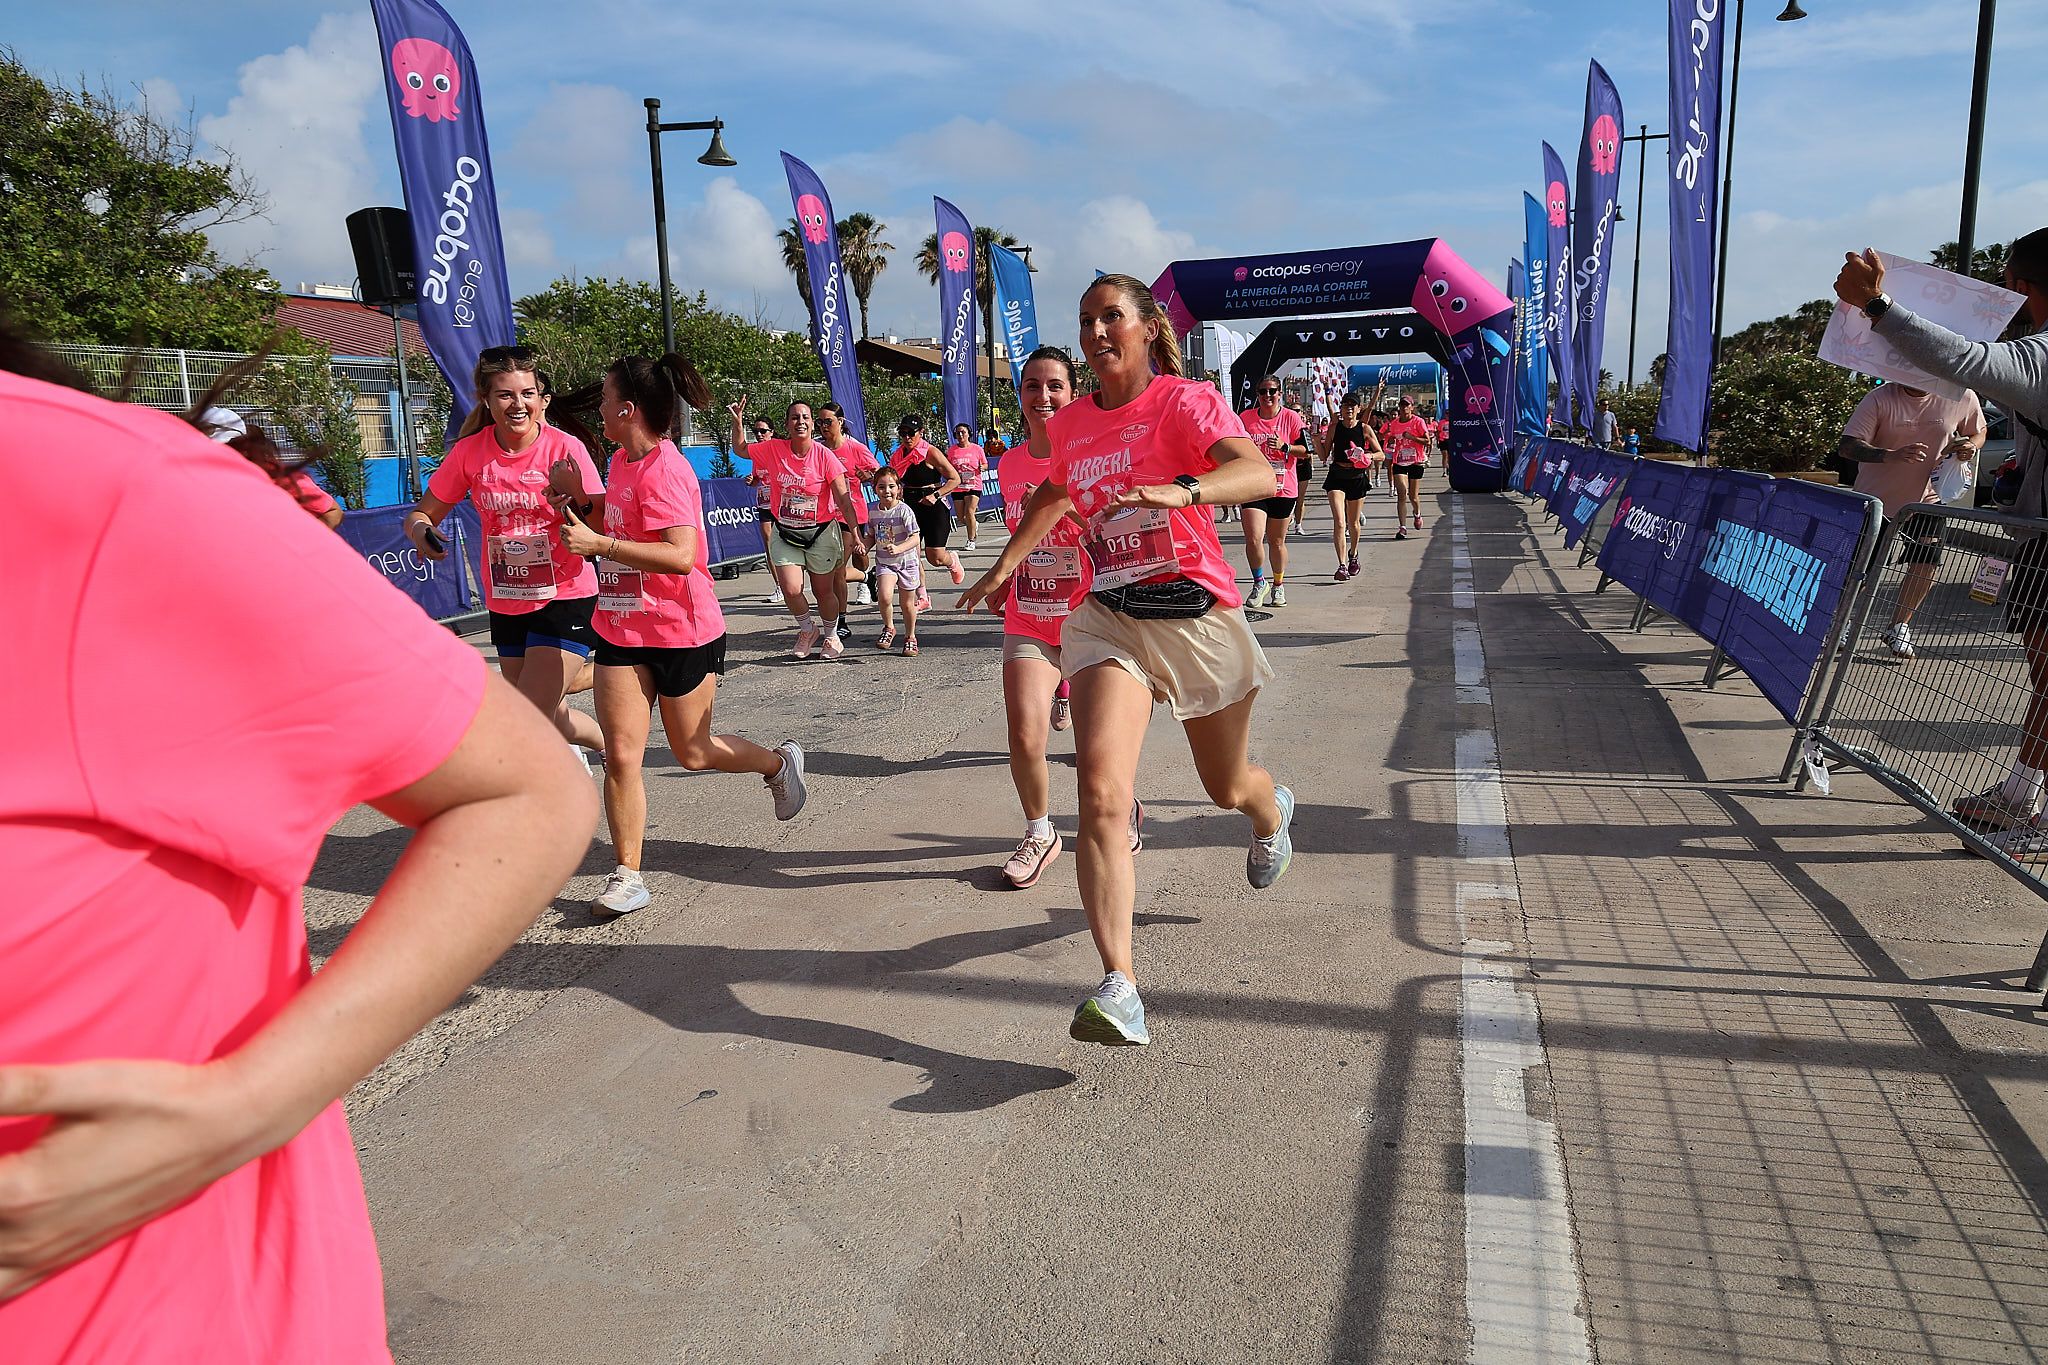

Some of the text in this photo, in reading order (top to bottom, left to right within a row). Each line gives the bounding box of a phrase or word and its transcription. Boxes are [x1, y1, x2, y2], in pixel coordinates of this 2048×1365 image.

[1253, 259, 1364, 279] octopus energy
[1225, 280, 1368, 298] LA ENERGÍA PARA CORRER
[1225, 291, 1372, 309] A LA VELOCIDAD DE LA LUZ
[1295, 326, 1414, 343] VOLVO
[1453, 418, 1480, 426] octopus
[1008, 482, 1027, 492] OYSH
[481, 491, 540, 511] CARRERA
[1106, 532, 1142, 553] 016
[367, 548, 434, 582] nergy
[507, 565, 530, 577] 016
[599, 572, 620, 585] 016
[1030, 578, 1057, 590] 016
[1098, 575, 1121, 586] OYSHO
